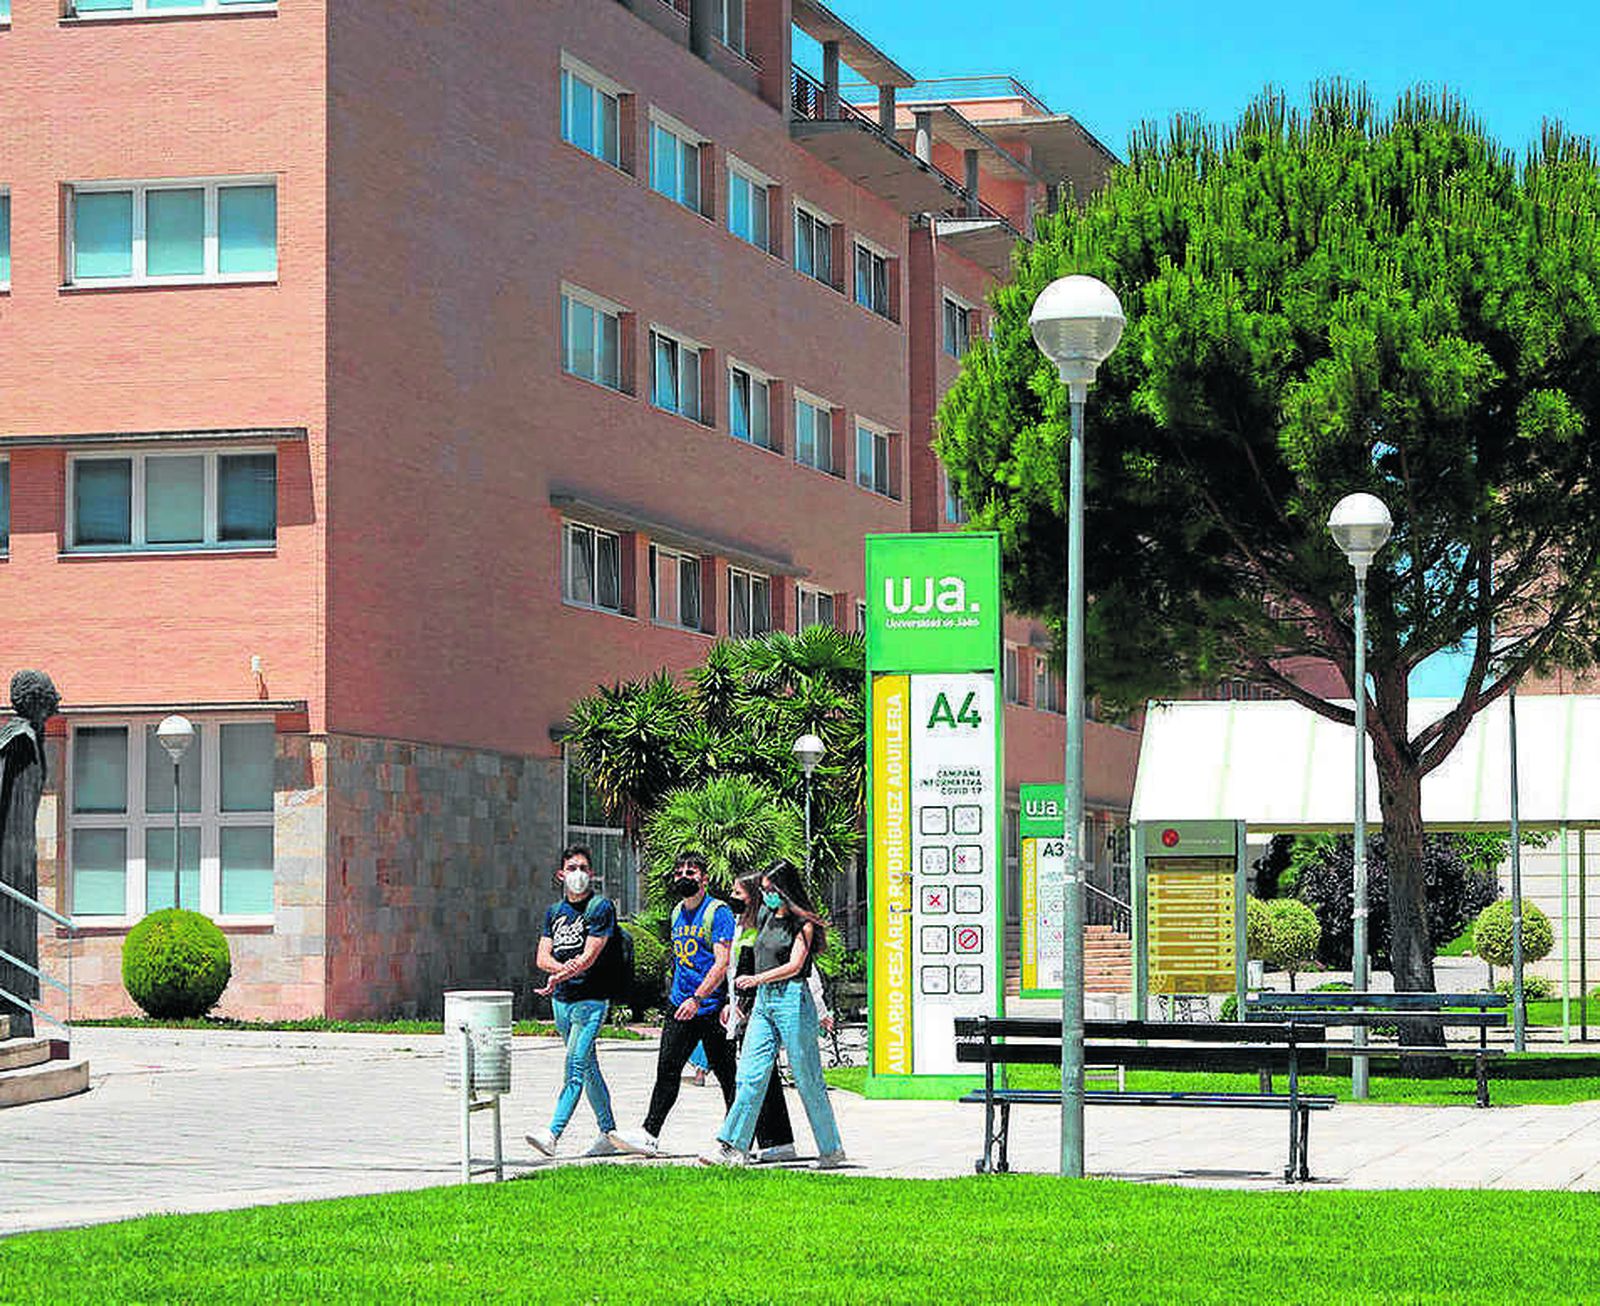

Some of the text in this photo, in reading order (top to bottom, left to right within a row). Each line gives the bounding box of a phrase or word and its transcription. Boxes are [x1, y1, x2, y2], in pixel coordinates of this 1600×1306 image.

[926, 691, 982, 728] A4
[884, 693, 904, 787] AGUILERA
[1043, 842, 1064, 857] A3
[887, 989, 906, 1073] AULARIO
